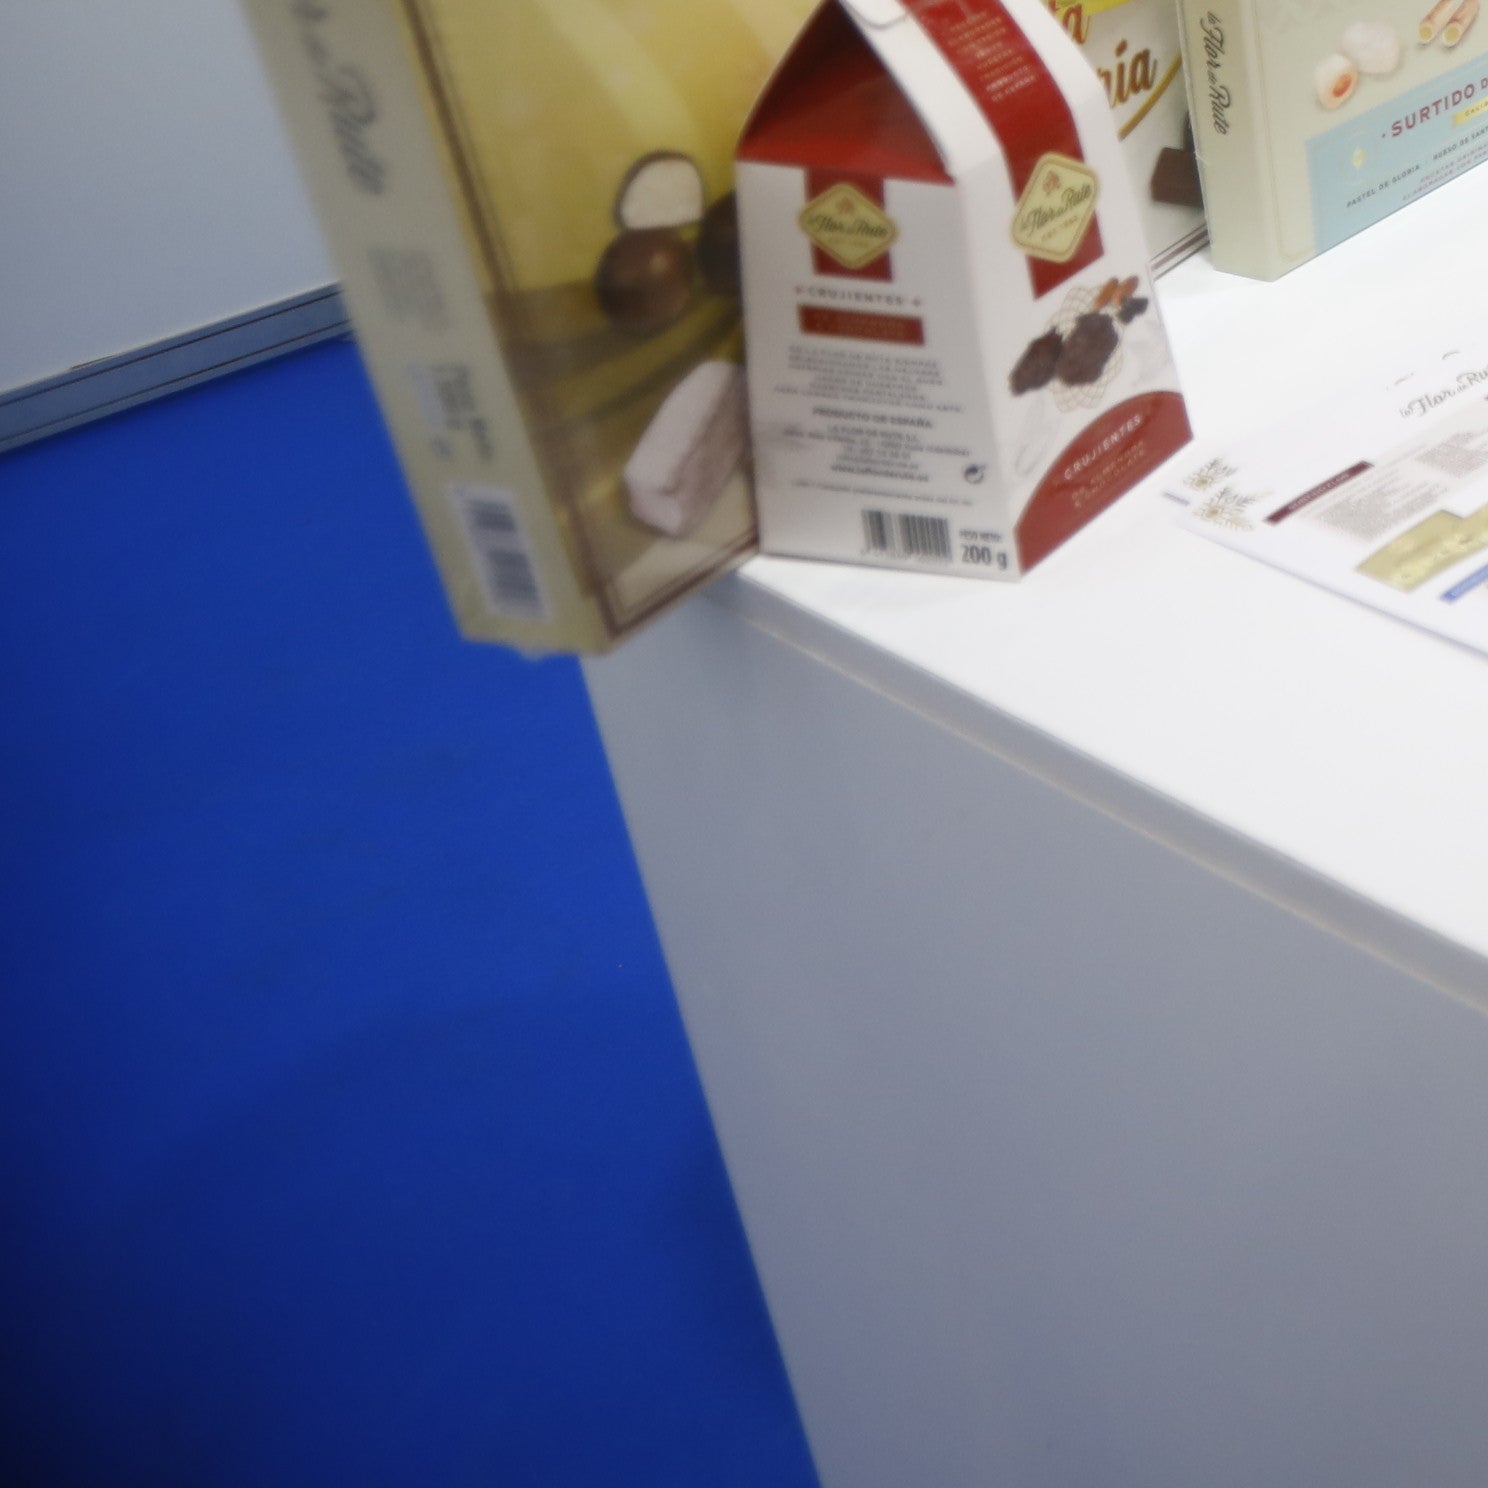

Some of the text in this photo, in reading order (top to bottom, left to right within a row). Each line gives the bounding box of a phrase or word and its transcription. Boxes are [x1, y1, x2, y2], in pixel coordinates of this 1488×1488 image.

[1200, 18, 1225, 69] Flor
[1209, 85, 1231, 135] Rute
[1391, 83, 1475, 139] SURTIDO
[961, 544, 992, 565] 200
